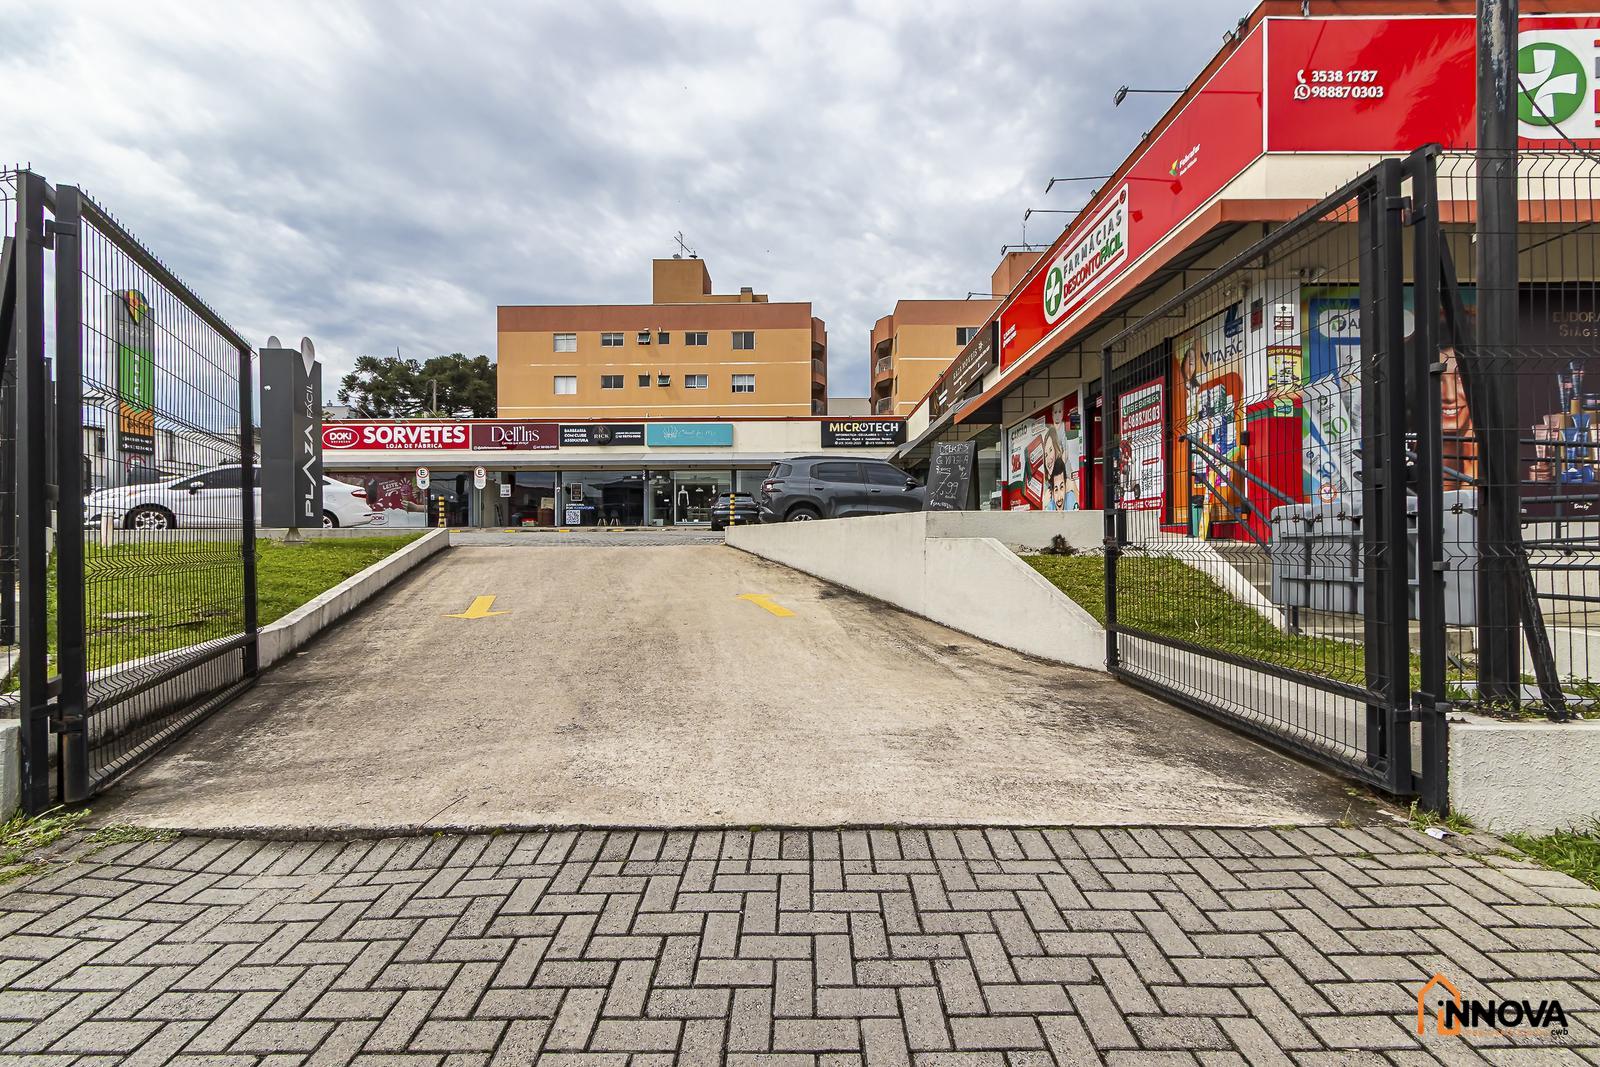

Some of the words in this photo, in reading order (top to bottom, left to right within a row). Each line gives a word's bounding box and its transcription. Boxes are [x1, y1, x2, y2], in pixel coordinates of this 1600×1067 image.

[1311, 70, 1343, 82] 3538
[1346, 70, 1378, 82] 1787
[1063, 208, 1122, 277] FARMÁCIAS
[304, 383, 314, 419] FÁCIL
[329, 432, 352, 440] DOKI
[363, 426, 465, 444] SORVETES
[829, 422, 899, 432] MICROTECH
[302, 424, 317, 517] PLAZA
